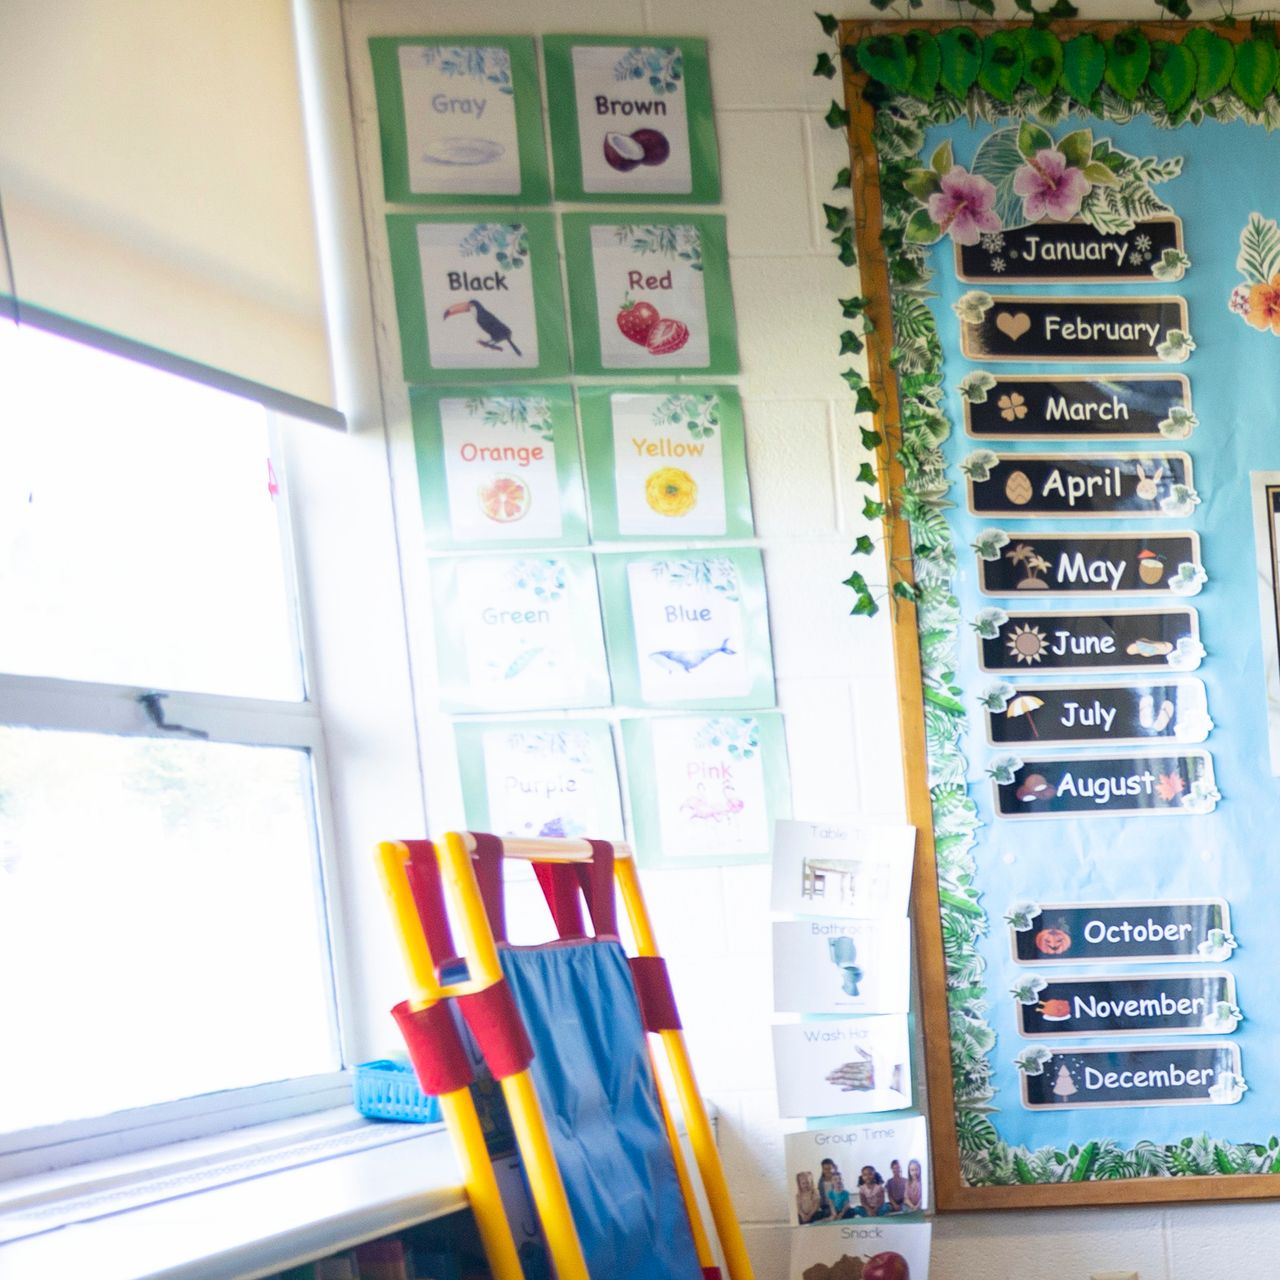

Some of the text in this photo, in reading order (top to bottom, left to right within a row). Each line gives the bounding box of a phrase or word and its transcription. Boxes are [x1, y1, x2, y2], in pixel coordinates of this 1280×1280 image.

[432, 92, 488, 118] Gray
[595, 95, 667, 116] Brown
[1022, 237, 1128, 266] January
[448, 271, 508, 292] Black
[629, 270, 673, 290] Red
[1045, 316, 1160, 346] February
[1046, 396, 1129, 421] March
[460, 442, 545, 468] Orange
[631, 438, 705, 459] Yellow
[1042, 467, 1121, 507] April
[1057, 553, 1127, 591] May
[481, 607, 550, 626] Green
[664, 604, 712, 623] Blue
[1052, 631, 1116, 655] June
[1061, 701, 1116, 732] July
[687, 761, 735, 781] Pink
[504, 775, 577, 799] Purple
[1056, 771, 1156, 804] August
[1084, 919, 1192, 943] October
[1074, 993, 1205, 1019] November
[803, 1028, 845, 1042] Wash
[1085, 1064, 1215, 1089] December
[814, 1126, 896, 1147] Group Time
[841, 1226, 884, 1240] Snack
